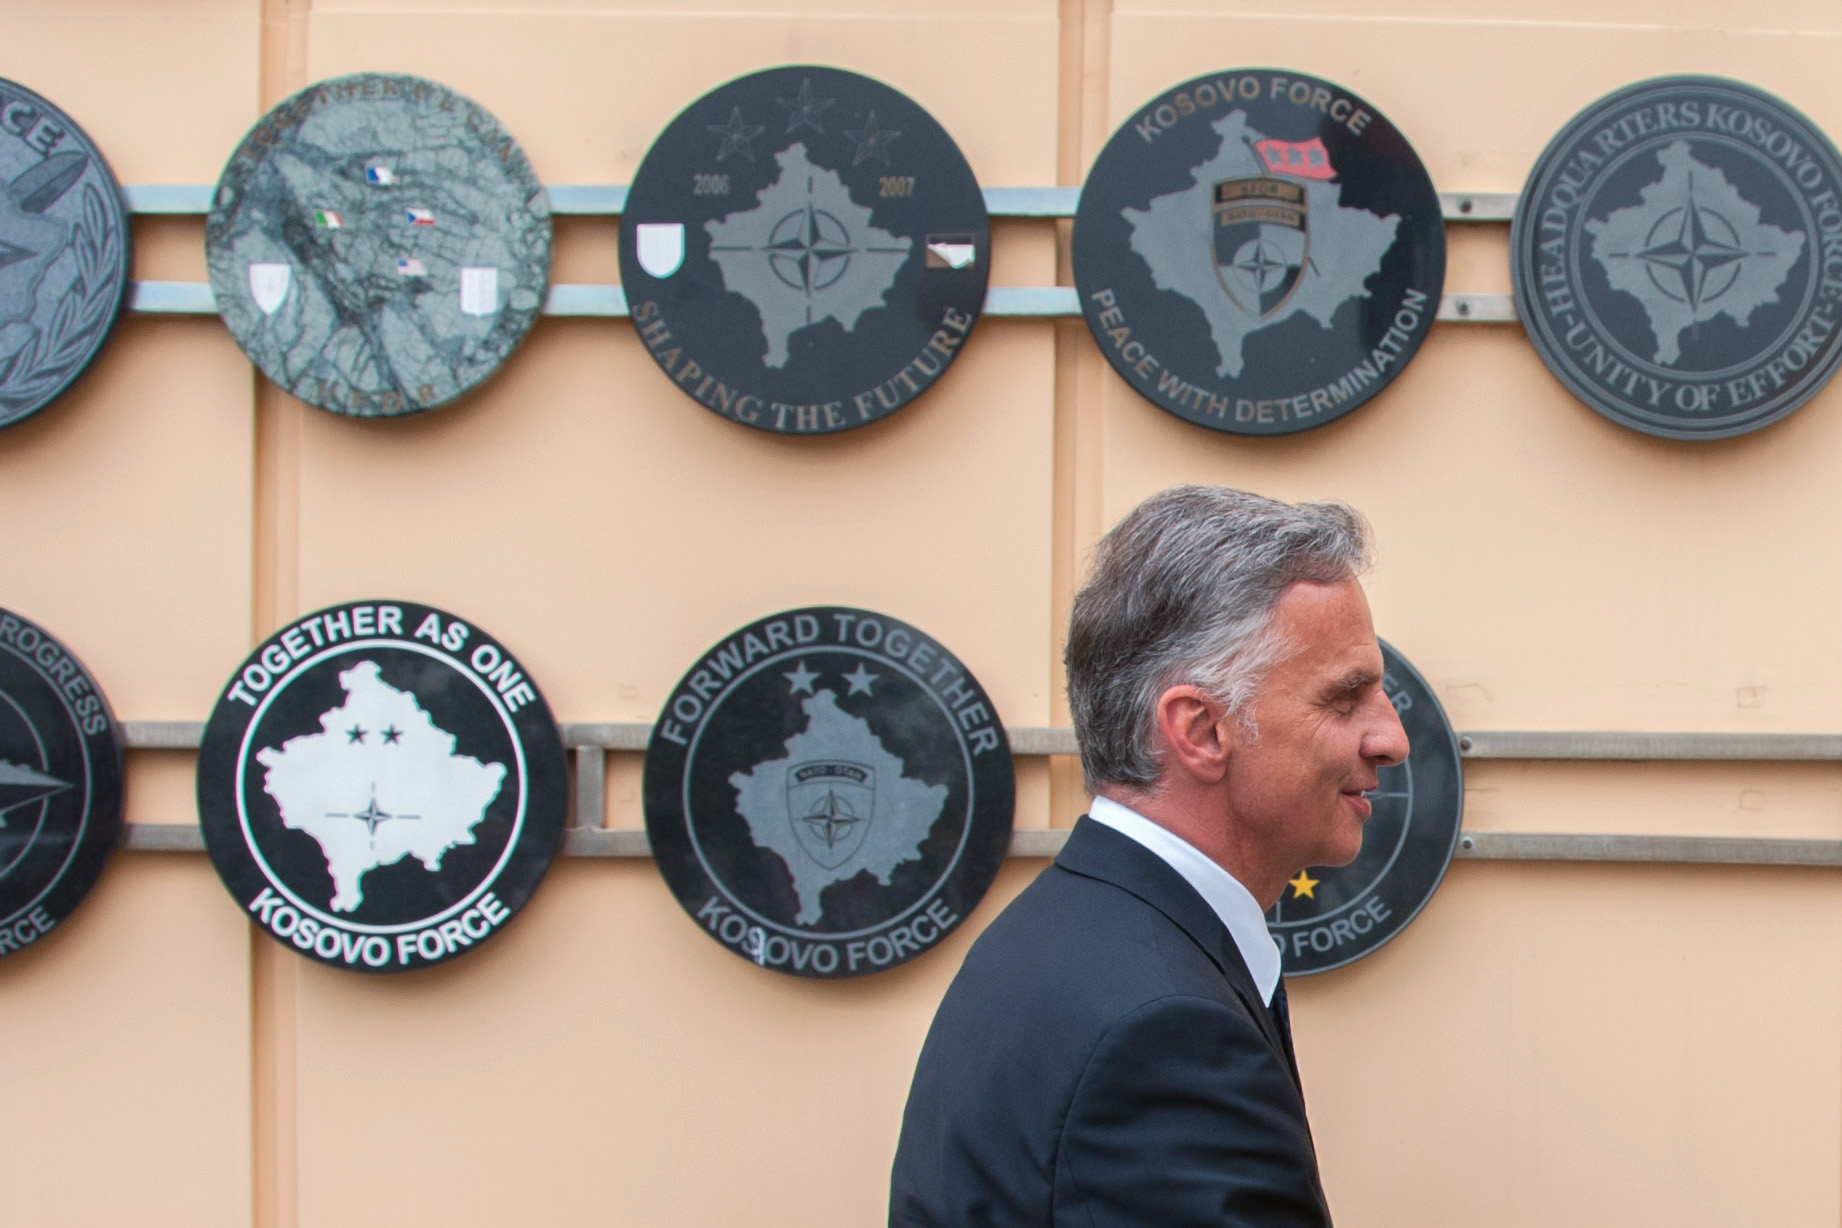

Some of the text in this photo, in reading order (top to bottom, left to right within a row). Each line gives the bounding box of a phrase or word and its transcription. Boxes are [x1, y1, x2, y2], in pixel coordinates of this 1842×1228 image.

[1134, 76, 1372, 143] KOSOVO FORCE
[1540, 101, 1701, 317] HEADQUARTERS
[1705, 102, 1822, 190] KOSOVO
[634, 300, 973, 431] SHAPING THE FUTURE
[1091, 286, 1429, 424] PEACE WITH DETERMINATION
[1674, 383, 1722, 412] OF
[227, 605, 538, 715] TOGETHER AS ONE
[661, 613, 1000, 757] FORWARD TOGETHER
[248, 886, 512, 968] KOSOVO FORCE
[696, 895, 959, 974] KOSOVO FORCE
[1292, 895, 1392, 958] FORCE
